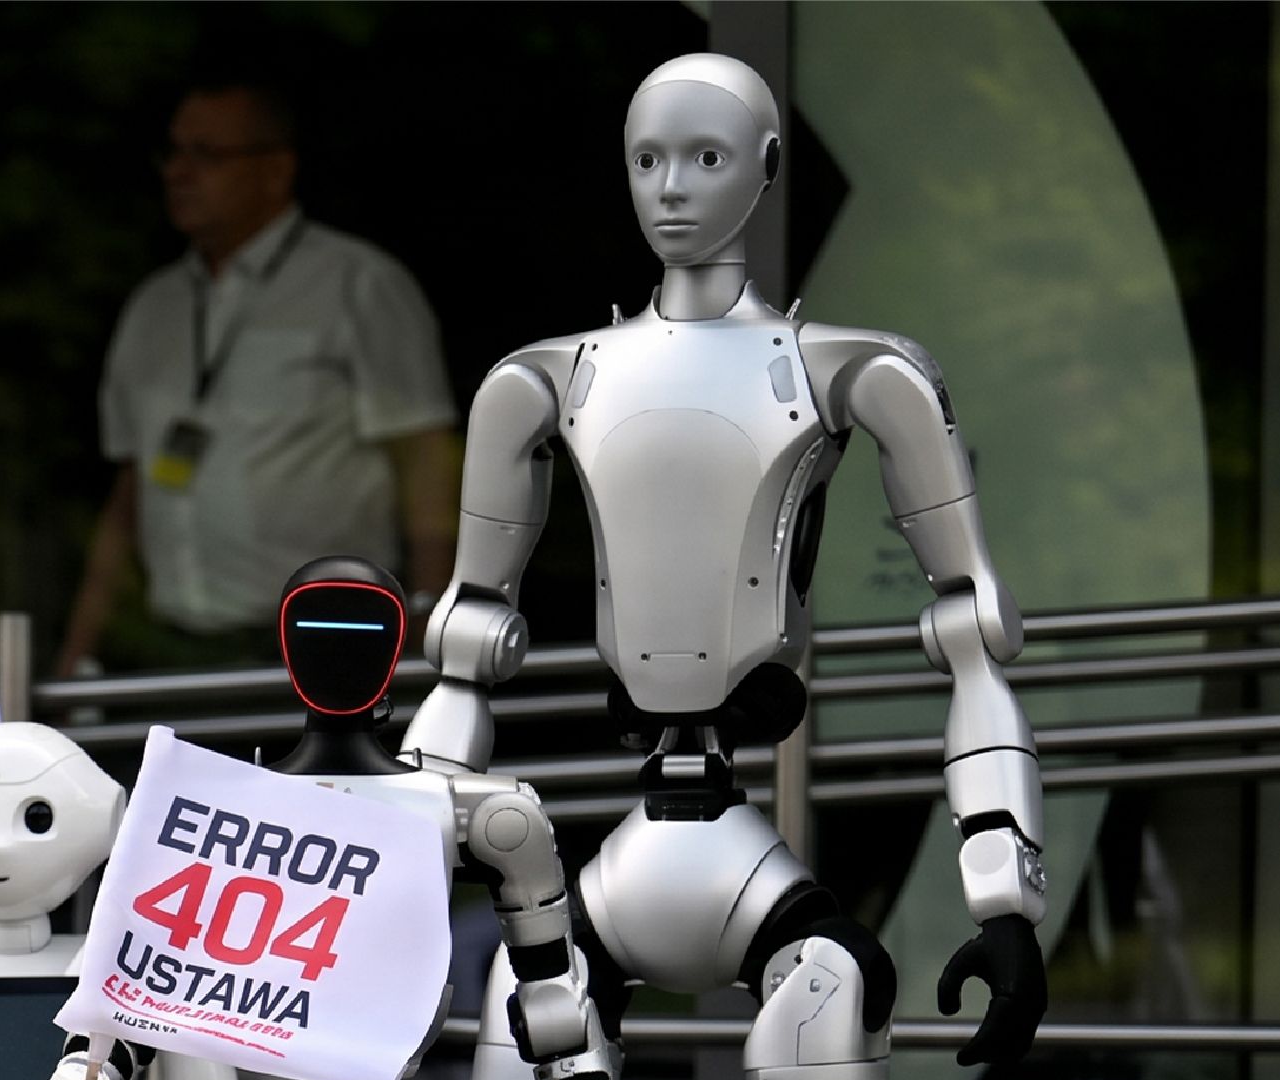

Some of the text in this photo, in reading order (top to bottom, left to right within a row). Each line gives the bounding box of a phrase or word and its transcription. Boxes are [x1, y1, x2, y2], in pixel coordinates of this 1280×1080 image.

[157, 795, 380, 896] ERROR
[132, 861, 351, 982] 404
[116, 930, 310, 1028] USTAWA
